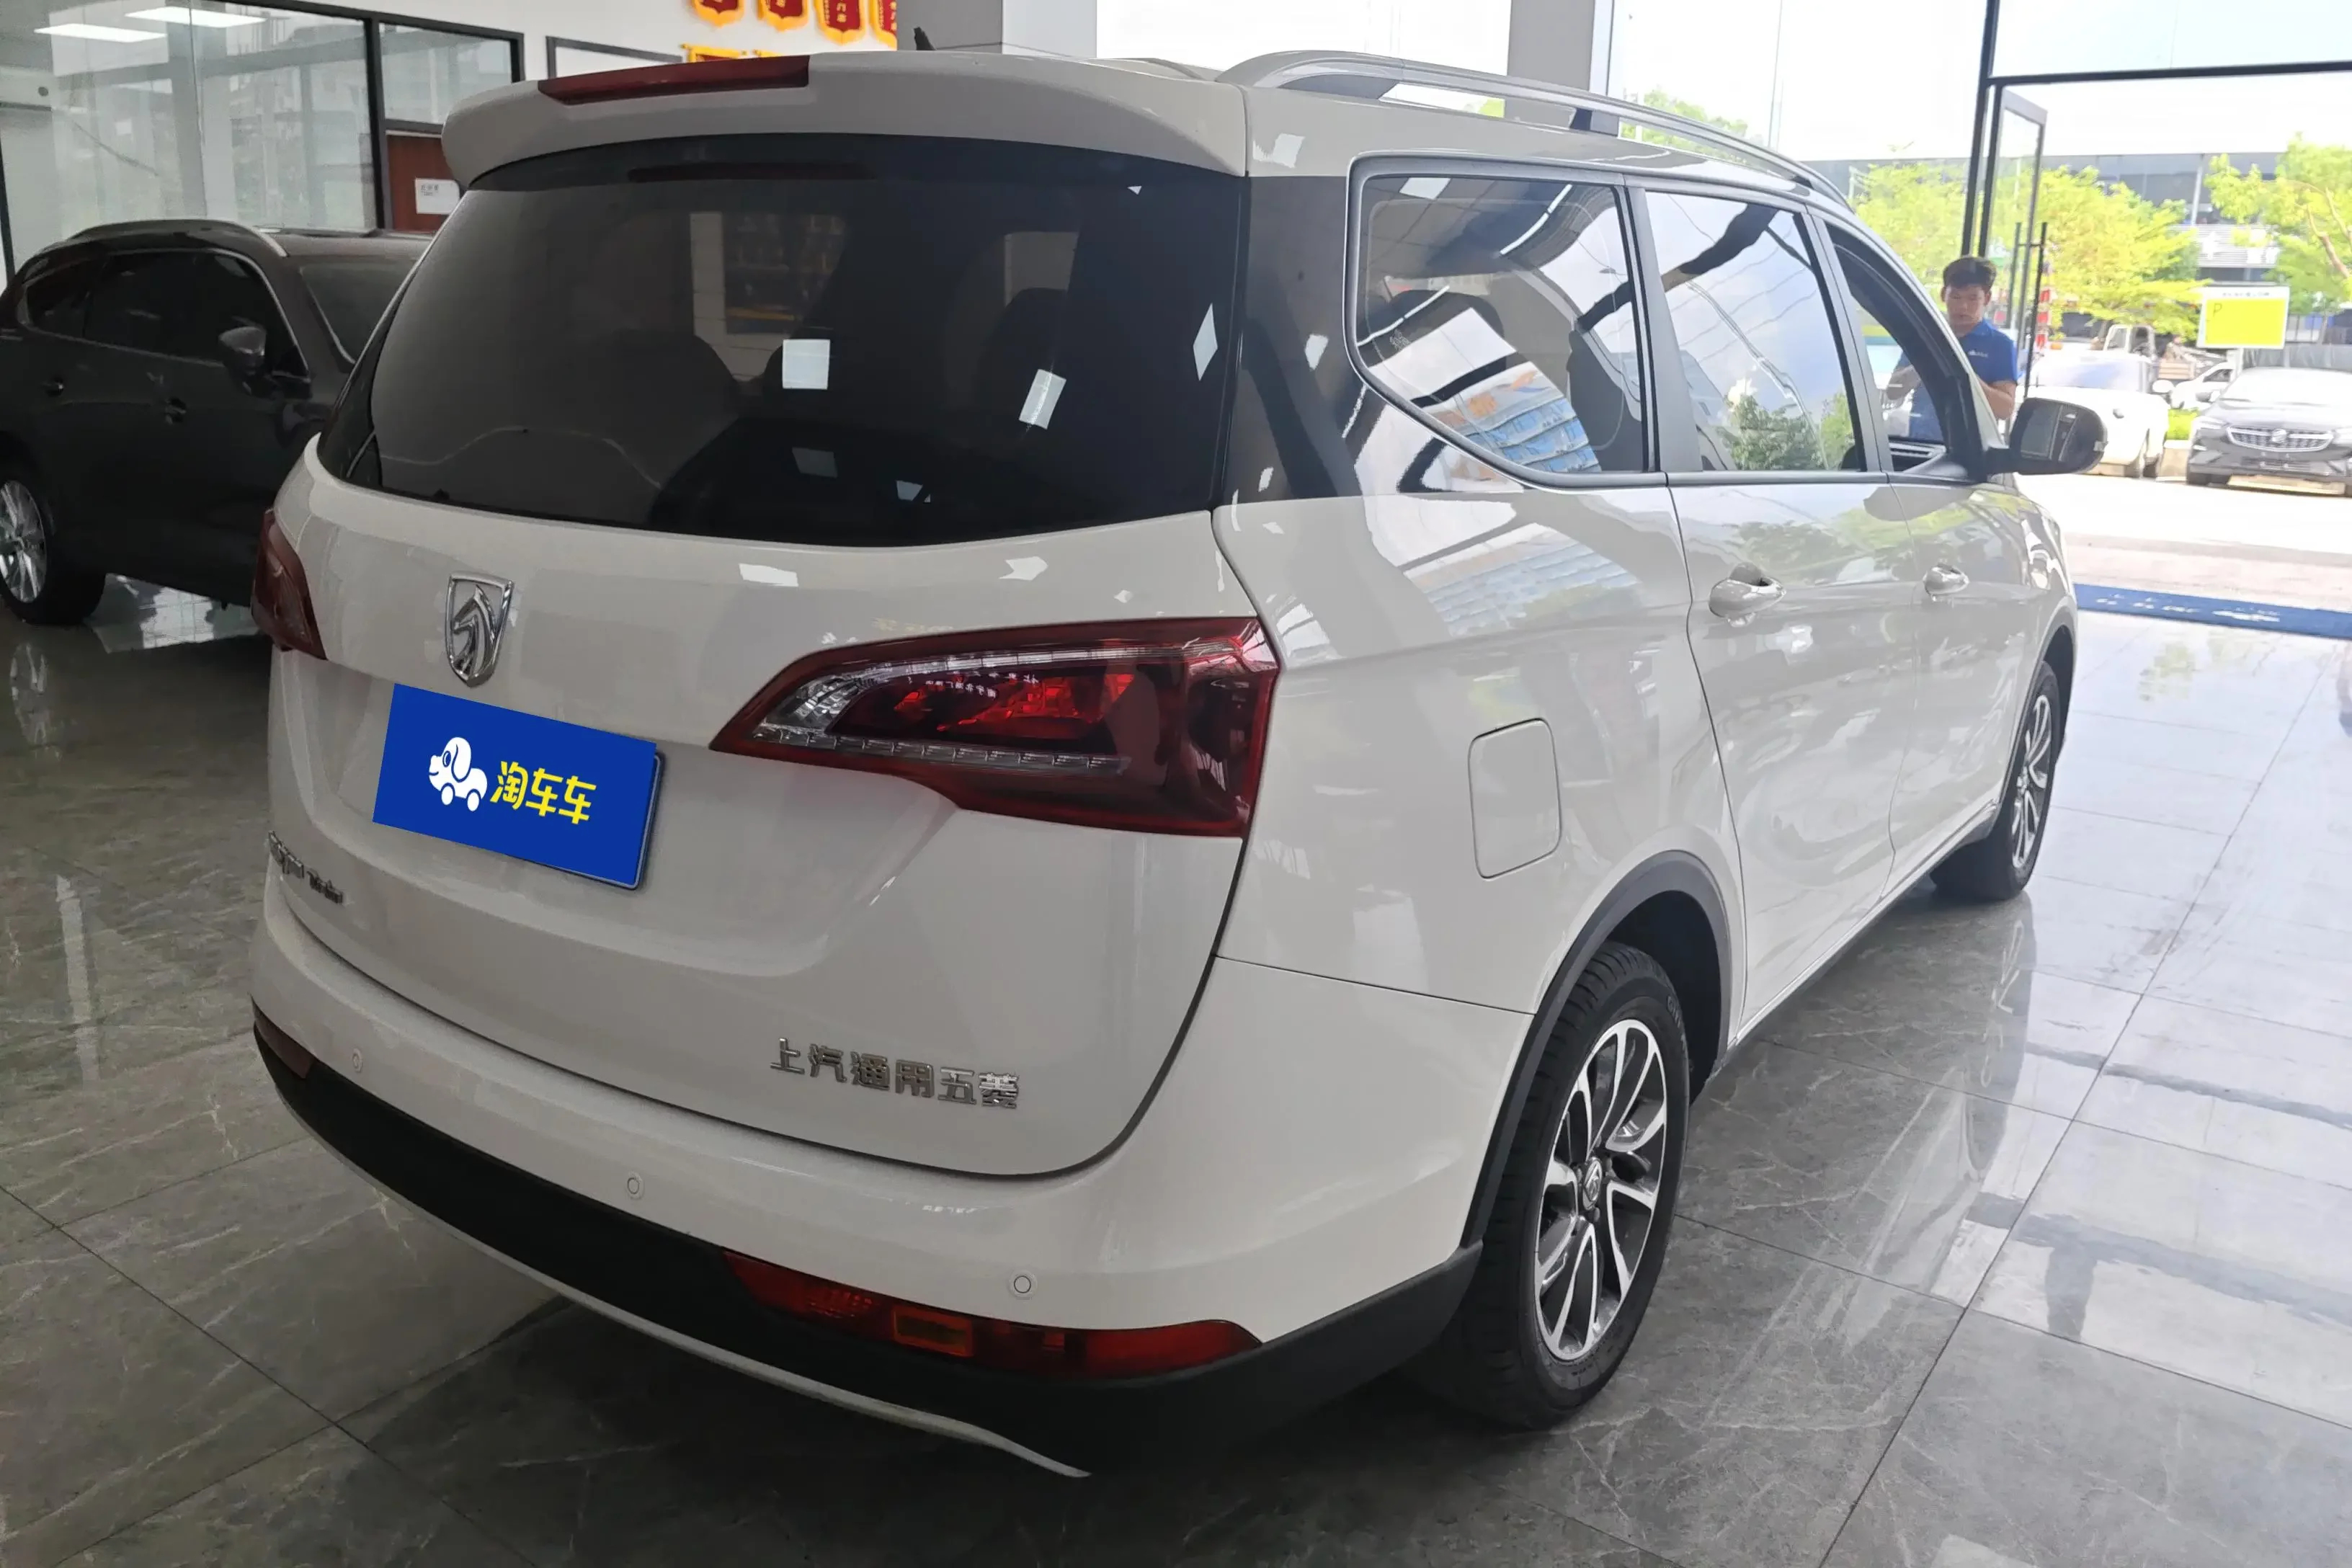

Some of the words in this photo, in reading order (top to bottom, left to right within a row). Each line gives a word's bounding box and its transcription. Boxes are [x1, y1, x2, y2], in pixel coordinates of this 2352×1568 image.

[770, 1037, 1020, 1110] 上汽通用五菱
